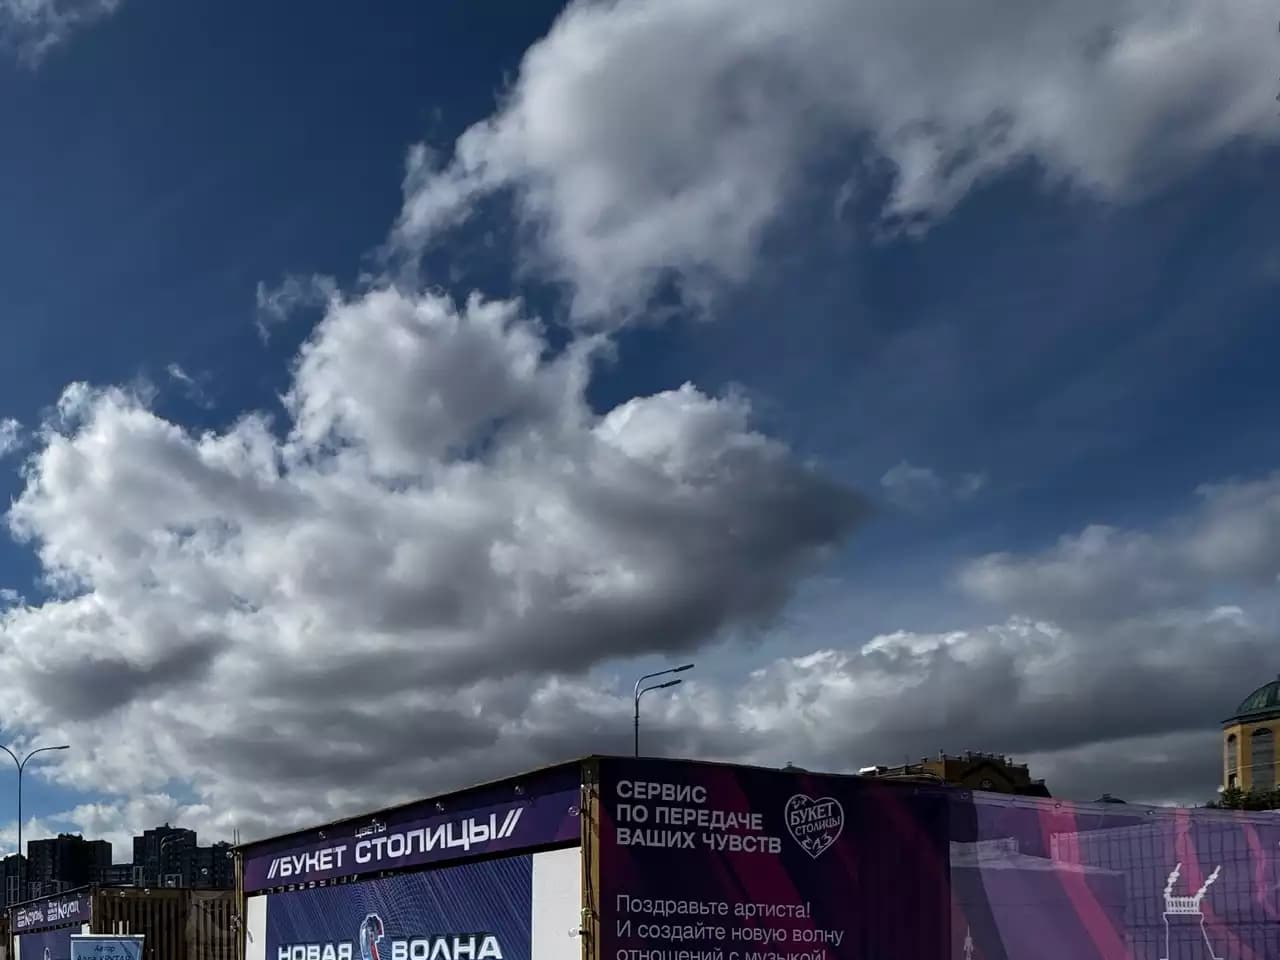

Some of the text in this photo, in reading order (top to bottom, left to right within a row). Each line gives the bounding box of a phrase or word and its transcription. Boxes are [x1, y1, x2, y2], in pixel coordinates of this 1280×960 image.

[616, 780, 707, 803] СЕРВИС
[616, 804, 763, 831] ПО ПЕРЕДАЧЕ
[790, 801, 834, 826] БУКЕТ
[794, 815, 841, 836] СТОЛИЦЫ
[616, 828, 782, 854] ВАШИХ ЧУВСТВ
[616, 894, 811, 919] Поздравьте артиста!
[616, 920, 845, 947] И создайте новую волну
